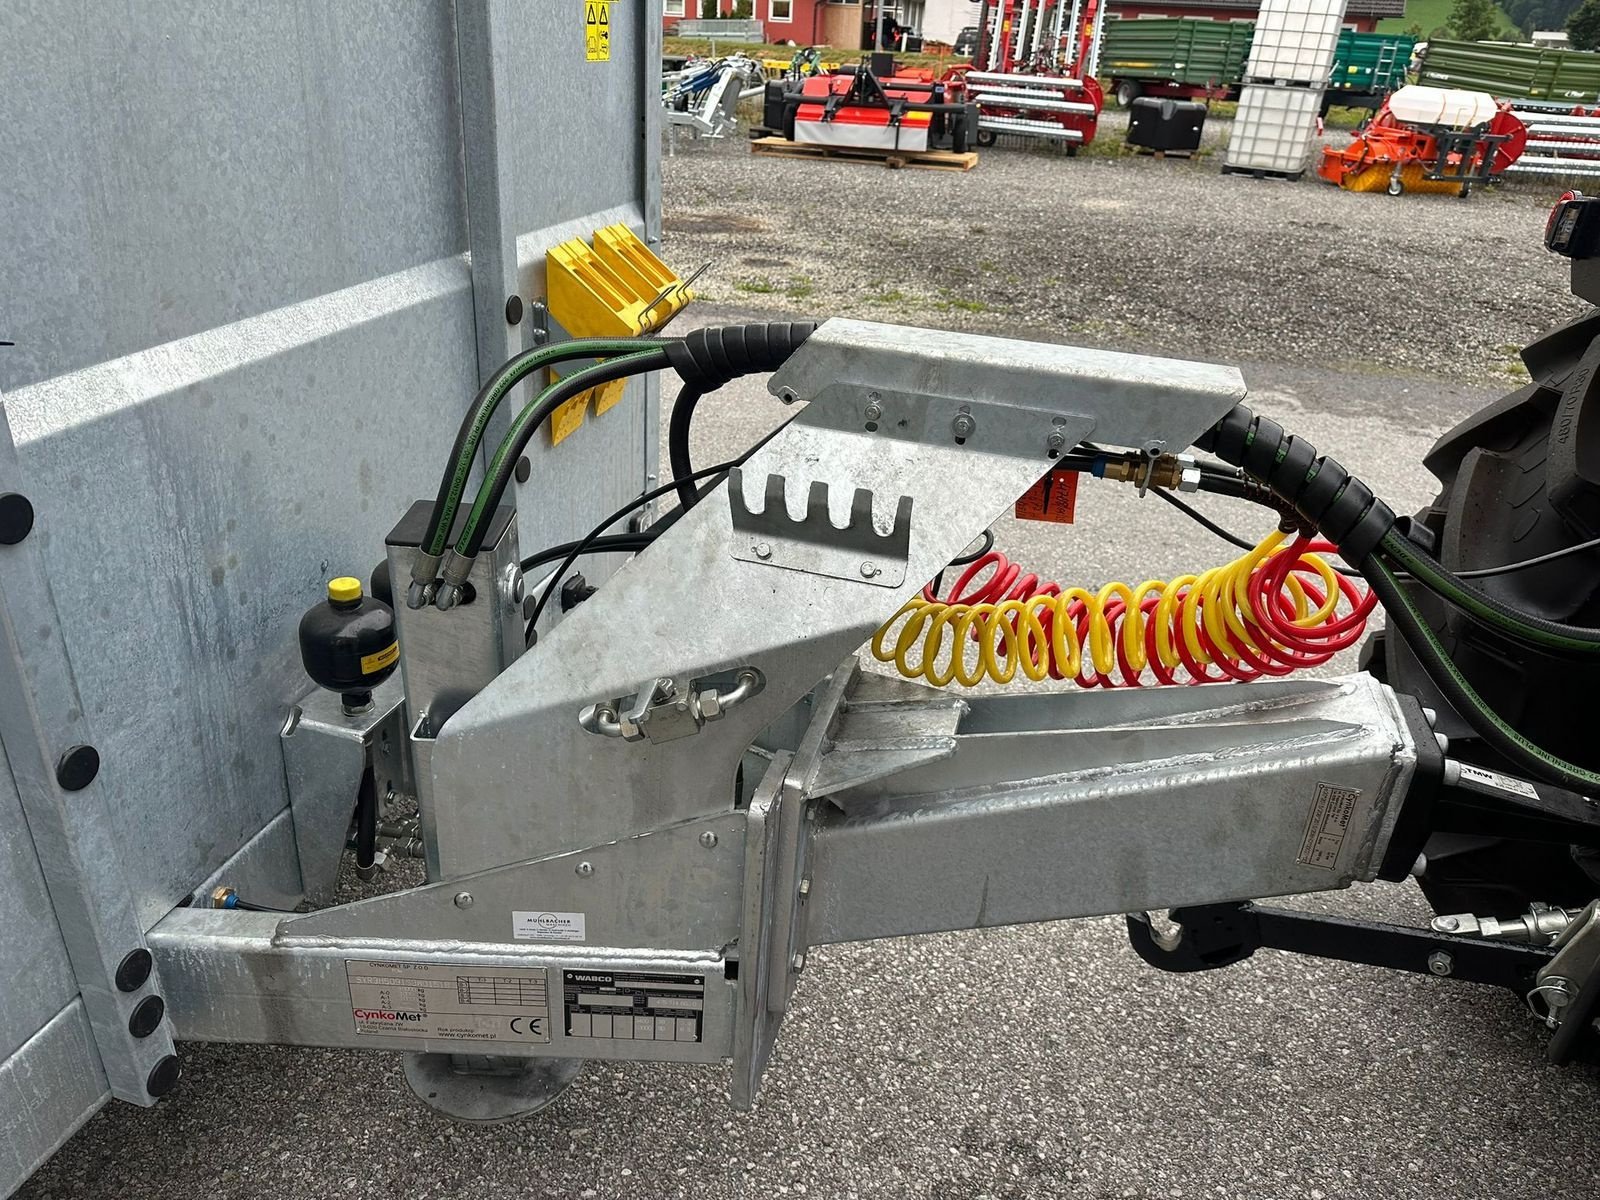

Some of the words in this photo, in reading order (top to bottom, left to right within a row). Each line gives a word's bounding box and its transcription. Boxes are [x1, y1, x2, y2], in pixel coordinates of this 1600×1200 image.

[478, 388, 500, 424] GREENLINE
[470, 426, 480, 446] PLUS
[1511, 732, 1536, 751] PLUS
[1534, 748, 1586, 777] GREENLINE
[1340, 794, 1355, 828] CynkoMet
